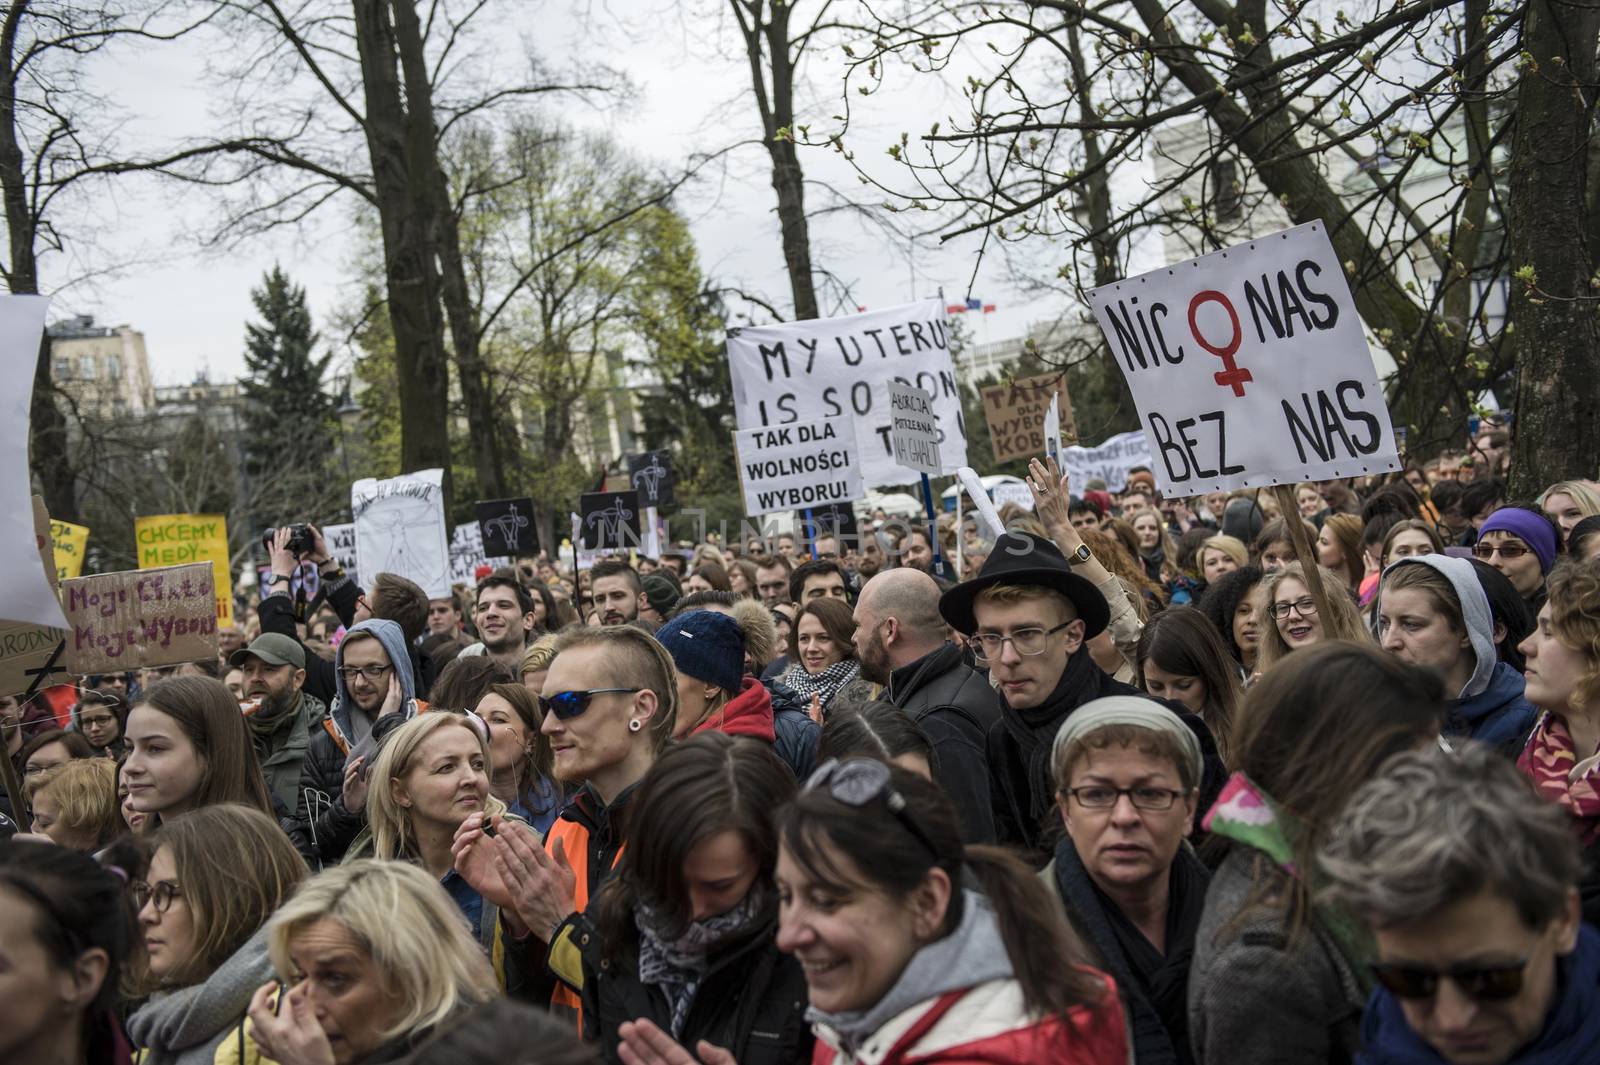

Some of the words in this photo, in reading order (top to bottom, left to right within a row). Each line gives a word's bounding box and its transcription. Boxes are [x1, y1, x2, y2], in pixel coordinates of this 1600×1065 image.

[1243, 259, 1339, 343] NAS
[758, 337, 818, 381] MY
[834, 318, 949, 367] UTERU
[758, 393, 798, 425] IS
[822, 380, 873, 418] SO
[891, 392, 930, 416] ABORCJA
[1017, 403, 1042, 416] DLA
[752, 428, 793, 449] TAK
[798, 422, 836, 443] DLA
[991, 409, 1067, 437] WYBOU
[1281, 380, 1381, 464] NAS
[996, 423, 1074, 457] KOBT
[1148, 410, 1245, 482] BEZ
[747, 449, 850, 481] WOLNOŚCI
[758, 481, 848, 510] WYBORU!
[138, 523, 217, 545] CHCEMY
[144, 543, 209, 564] MEDY-
